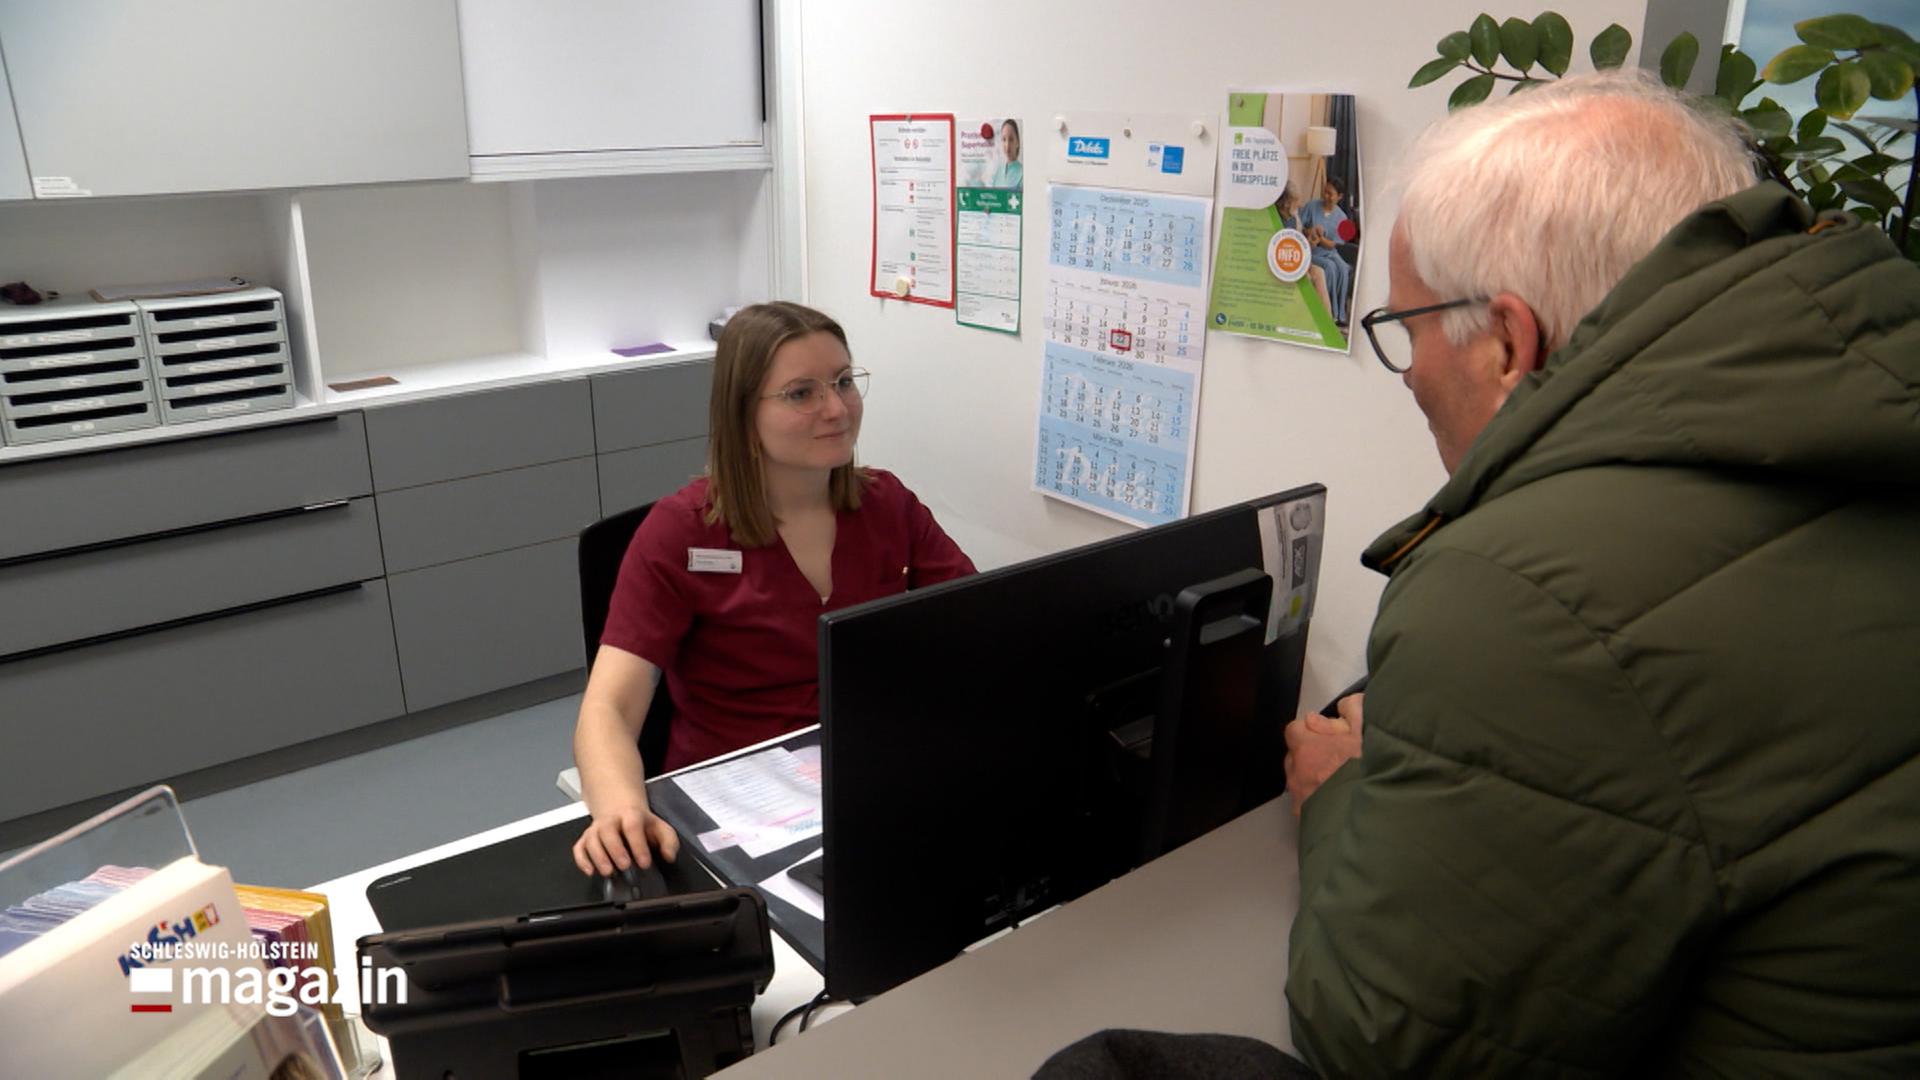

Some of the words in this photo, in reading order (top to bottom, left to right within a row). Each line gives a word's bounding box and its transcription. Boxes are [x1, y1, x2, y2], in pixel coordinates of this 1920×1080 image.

[1232, 148, 1250, 160] FREIE
[1253, 147, 1279, 162] PLÄTZE
[1232, 161, 1239, 171] IN
[1240, 162, 1254, 172] DER
[1232, 173, 1279, 187] TAGESPFLEGE
